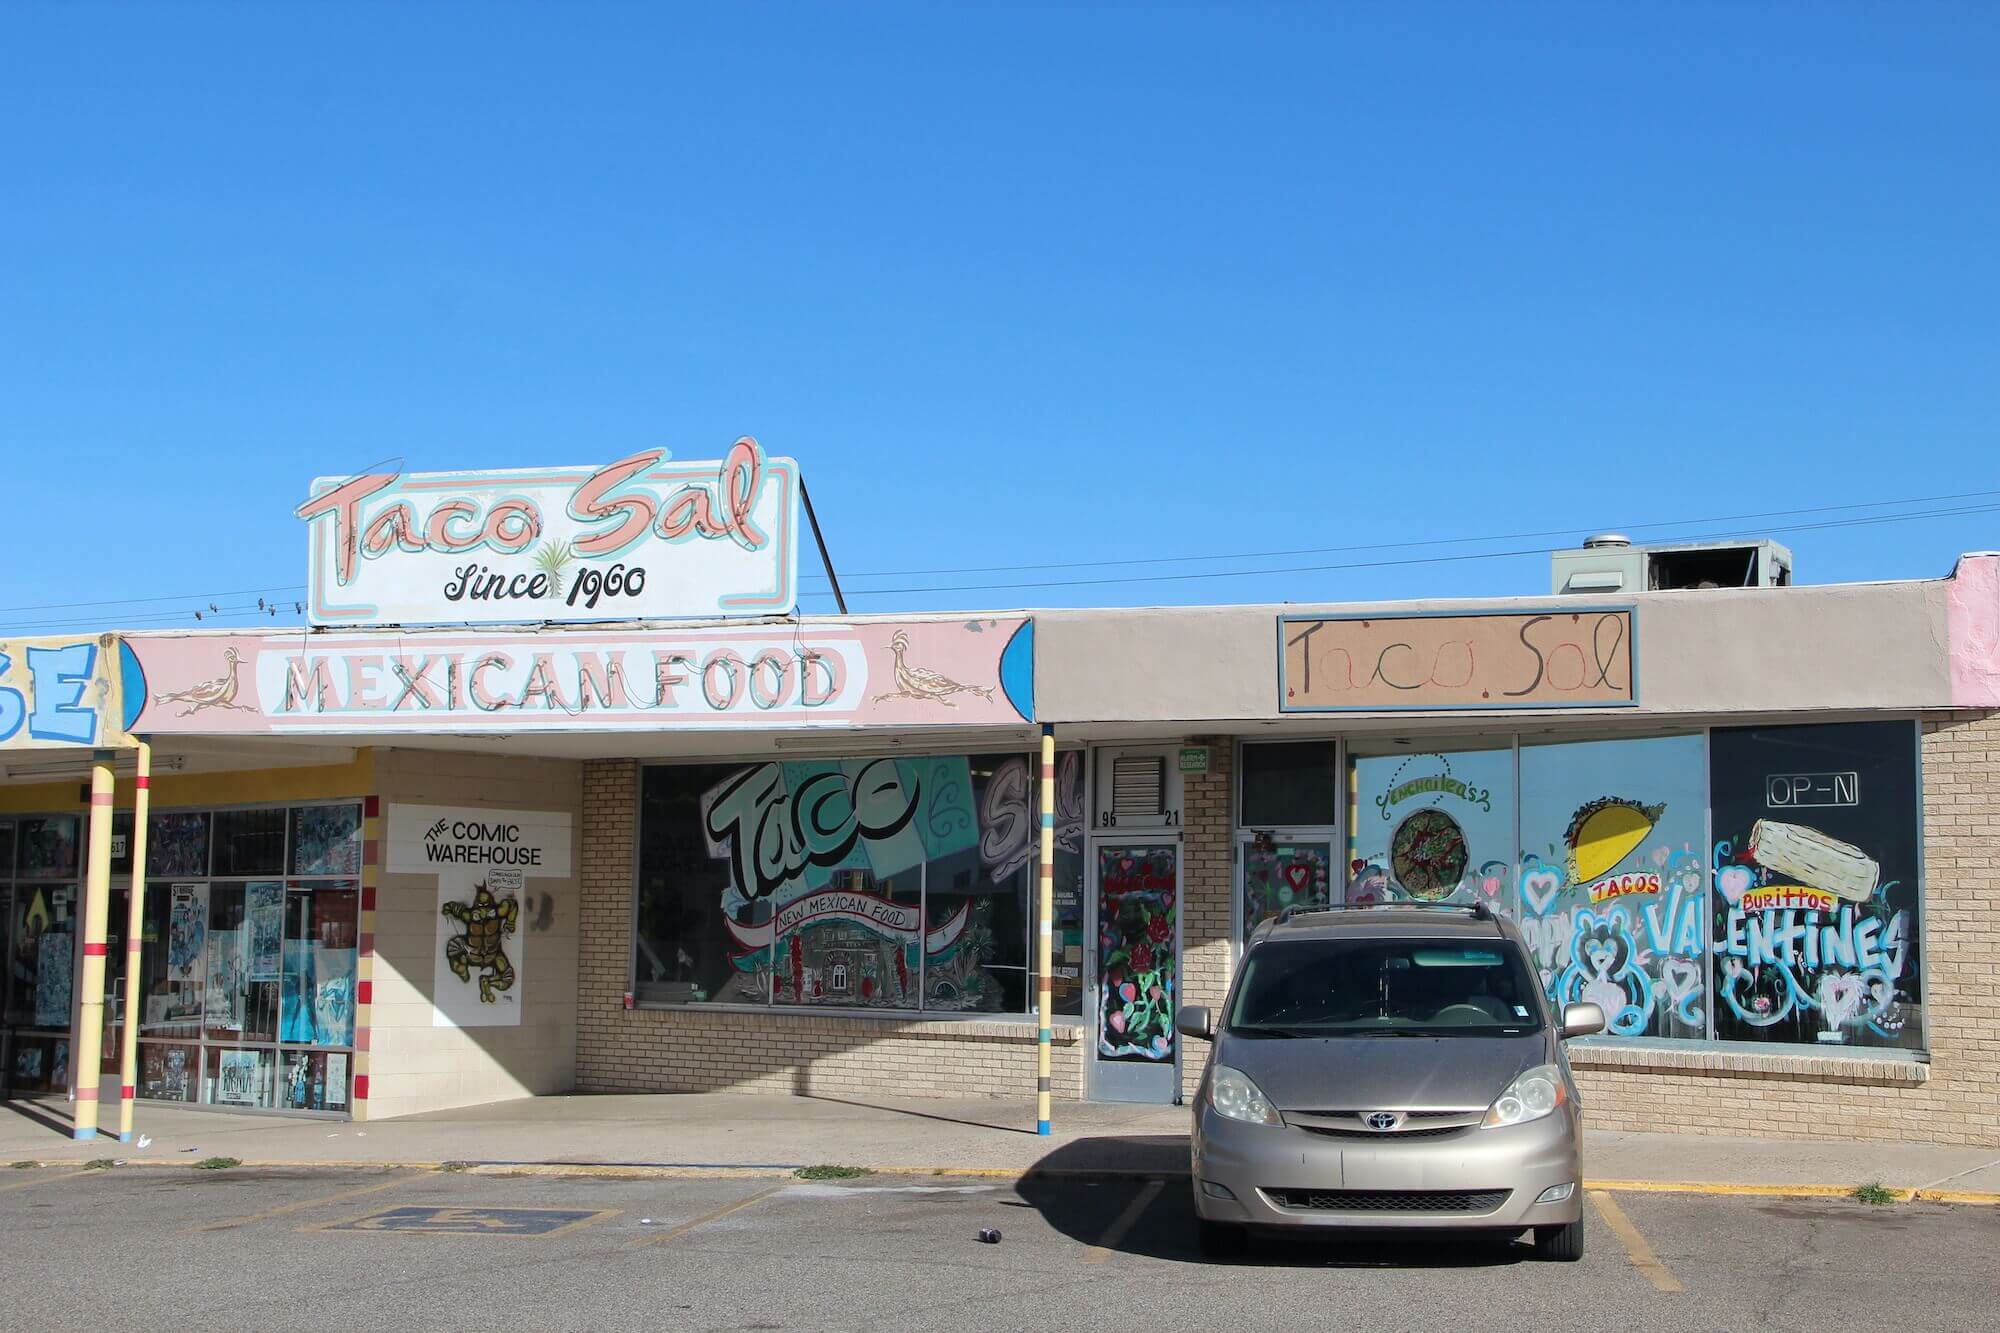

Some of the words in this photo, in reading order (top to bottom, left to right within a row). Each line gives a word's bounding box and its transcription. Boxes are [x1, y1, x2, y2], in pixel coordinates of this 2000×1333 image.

[294, 470, 543, 587] Taco
[566, 435, 768, 560] Sal
[444, 564, 548, 602] Since
[565, 566, 646, 608] 1960
[1288, 620, 1475, 694] Taco
[1503, 614, 1624, 697] Sal
[273, 650, 628, 714] MEXICAN
[655, 646, 849, 711] FOOD
[424, 818, 449, 842] THE
[452, 821, 520, 843] COMIC
[1102, 811, 1117, 826] 96
[1164, 809, 1179, 825] 21
[426, 843, 542, 866] WAREHOUSE
[1592, 873, 1660, 899] TACOS
[779, 906, 804, 928] NEW
[809, 896, 868, 914] MEXICAN
[871, 905, 906, 926] FOOD
